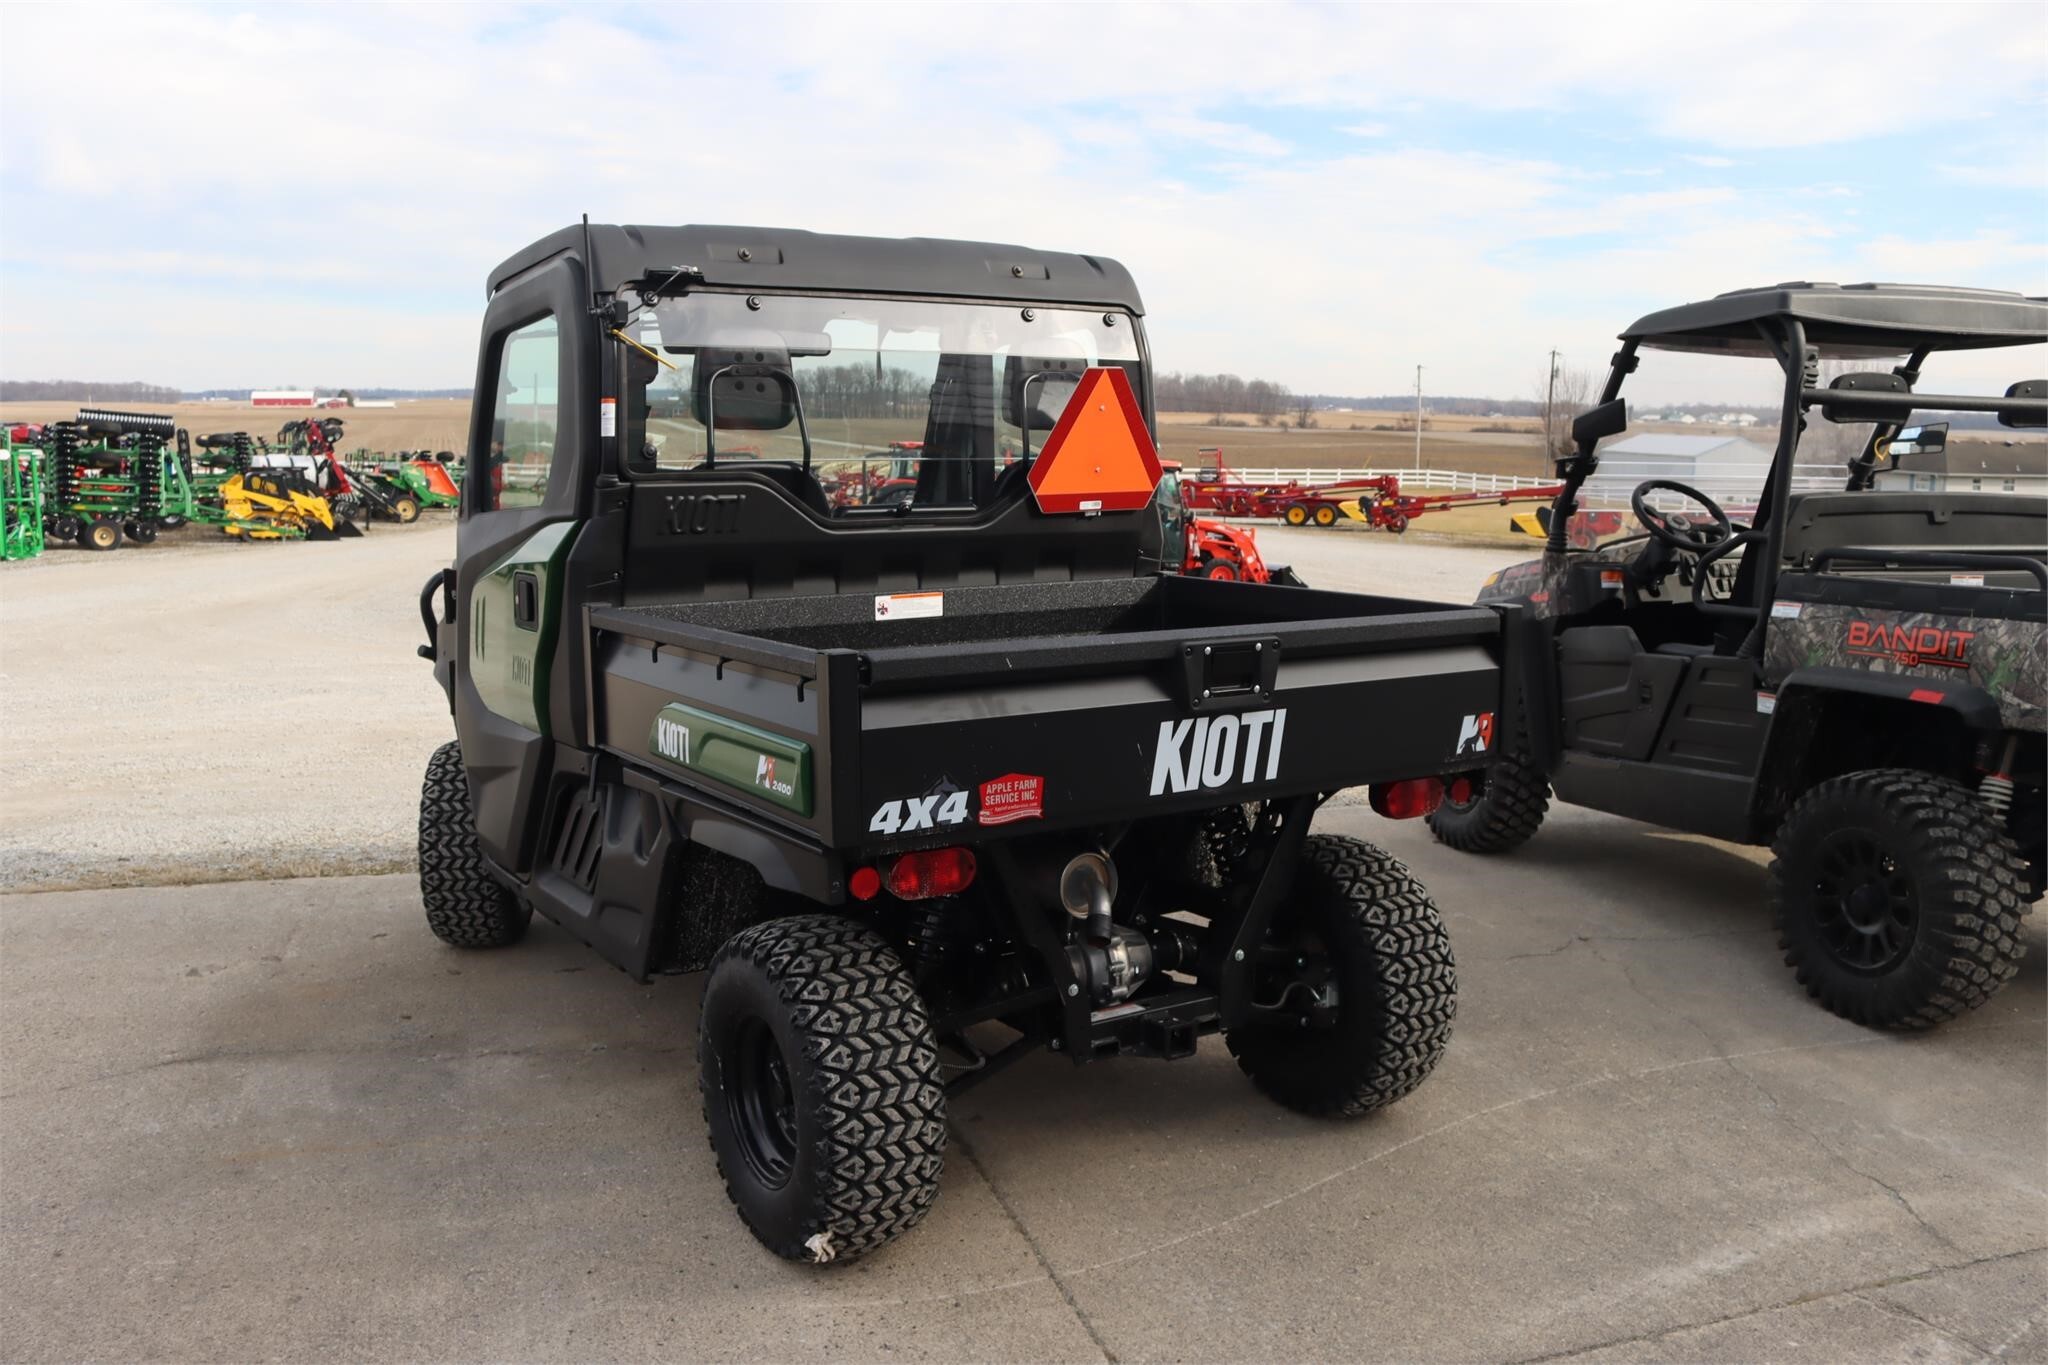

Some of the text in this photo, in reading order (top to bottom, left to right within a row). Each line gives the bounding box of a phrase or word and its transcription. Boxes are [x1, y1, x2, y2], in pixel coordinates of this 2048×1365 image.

[657, 494, 747, 535] KIOTI
[1847, 621, 1975, 658] BANDIT
[1893, 651, 1919, 666] 750
[658, 718, 690, 764] KIOTI
[1149, 708, 1288, 796] KIOTI
[772, 780, 792, 796] 2400
[985, 790, 1038, 806] SERVICE INC.
[986, 778, 1037, 795] APPLE FARM
[869, 791, 969, 835] 4X4
